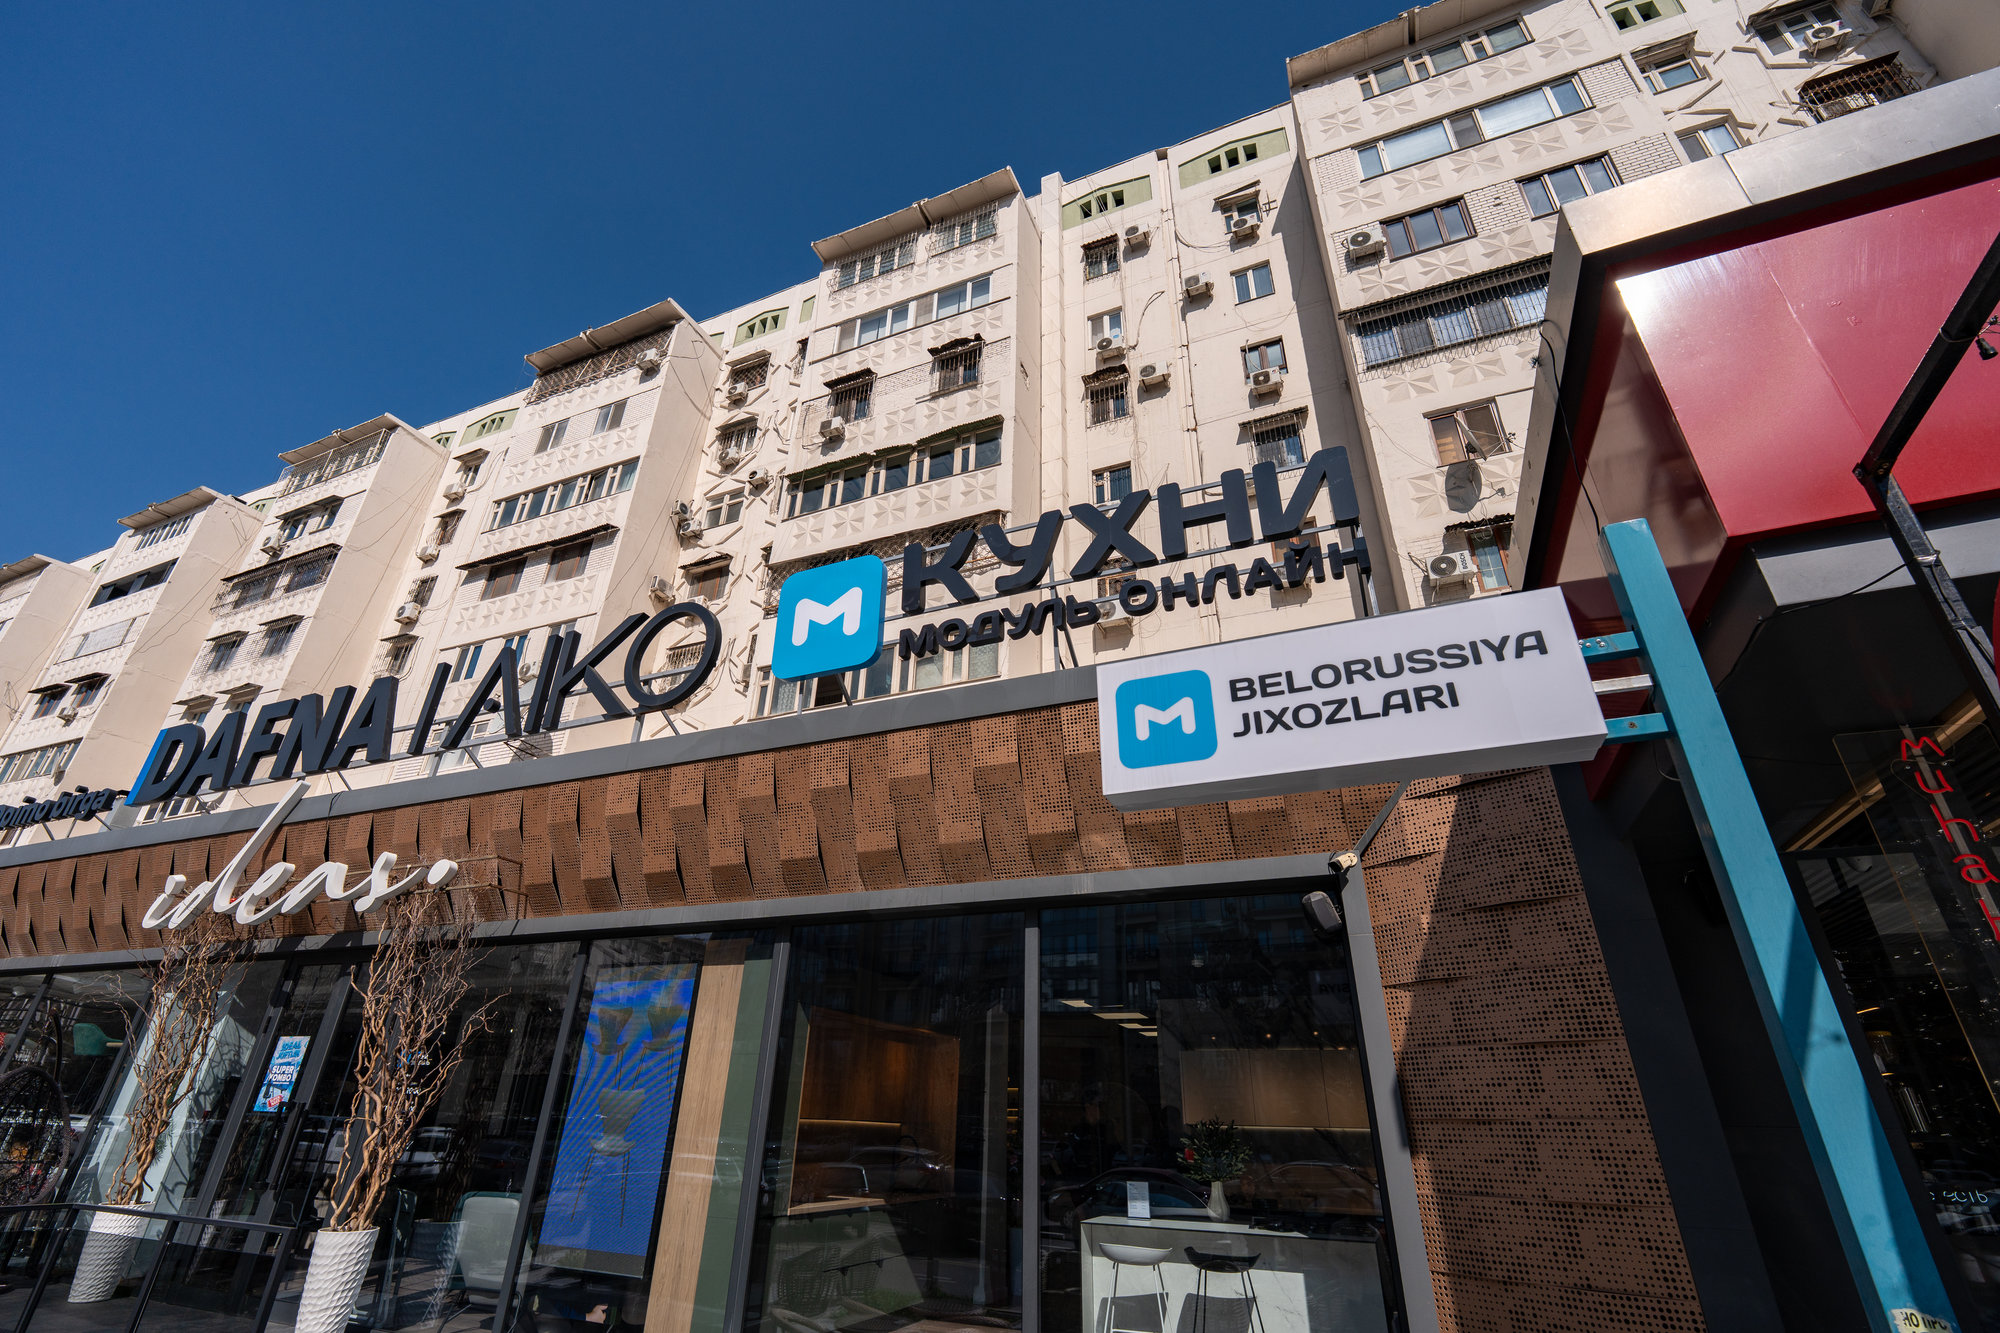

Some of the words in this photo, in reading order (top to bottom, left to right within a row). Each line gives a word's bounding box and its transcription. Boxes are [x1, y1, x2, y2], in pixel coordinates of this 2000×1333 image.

[902, 446, 1360, 615] КУХНИ
[898, 594, 1101, 661] МОДУЛЬ
[1119, 536, 1371, 617] ОНЛАЙН
[1229, 629, 1548, 703] BELORUSSIYA
[125, 676, 399, 806] DAFNA
[1233, 681, 1460, 738] JIXOZLARI
[49, 784, 118, 822] birga
[271, 1065, 295, 1074] SUPER
